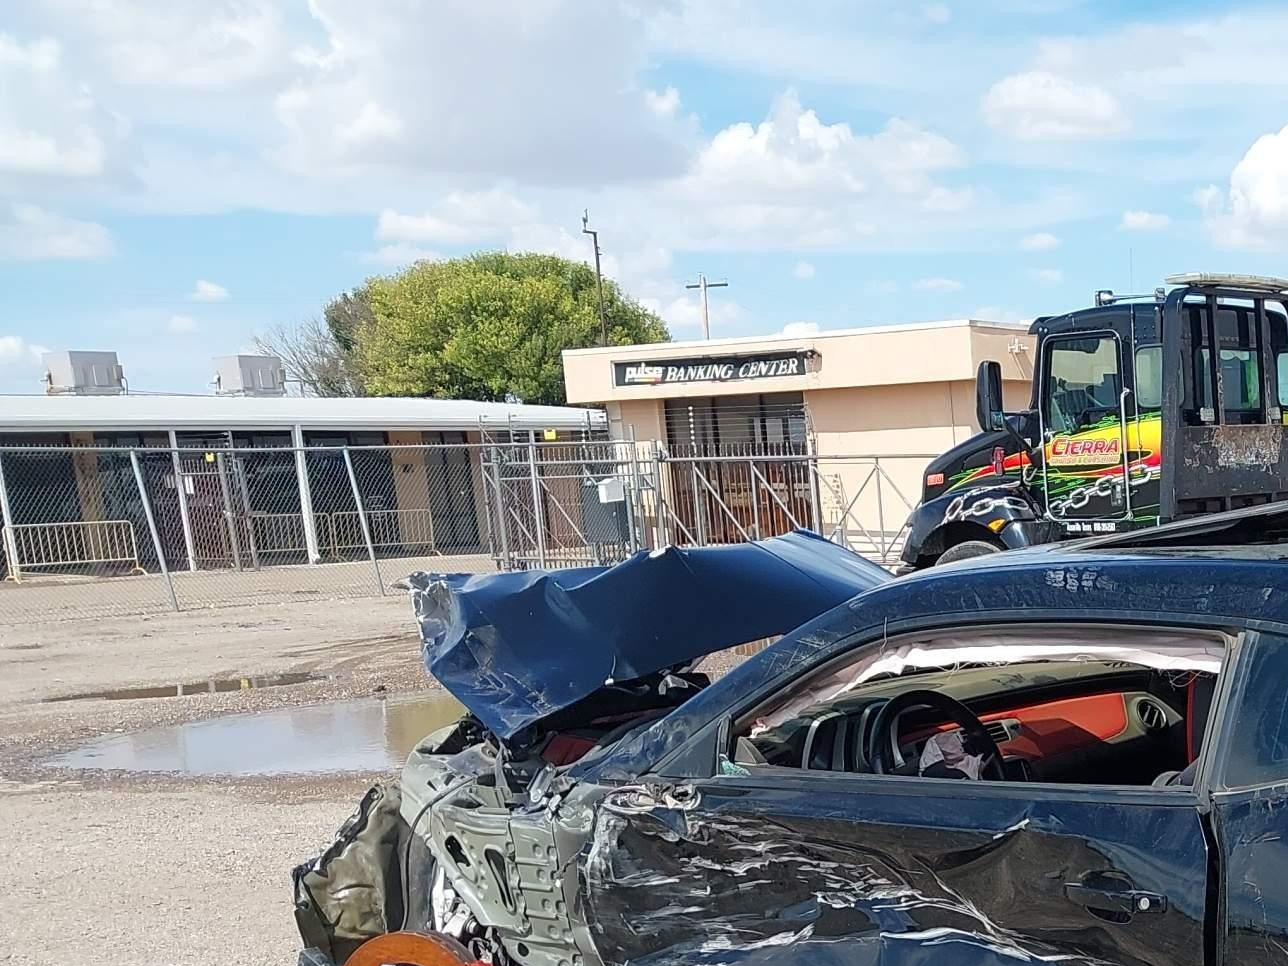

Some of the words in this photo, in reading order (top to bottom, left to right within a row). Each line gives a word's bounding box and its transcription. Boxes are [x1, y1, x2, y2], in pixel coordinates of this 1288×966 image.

[664, 364, 735, 381] BANKING
[738, 358, 799, 378] CENTER
[1052, 438, 1119, 456] CIERRA
